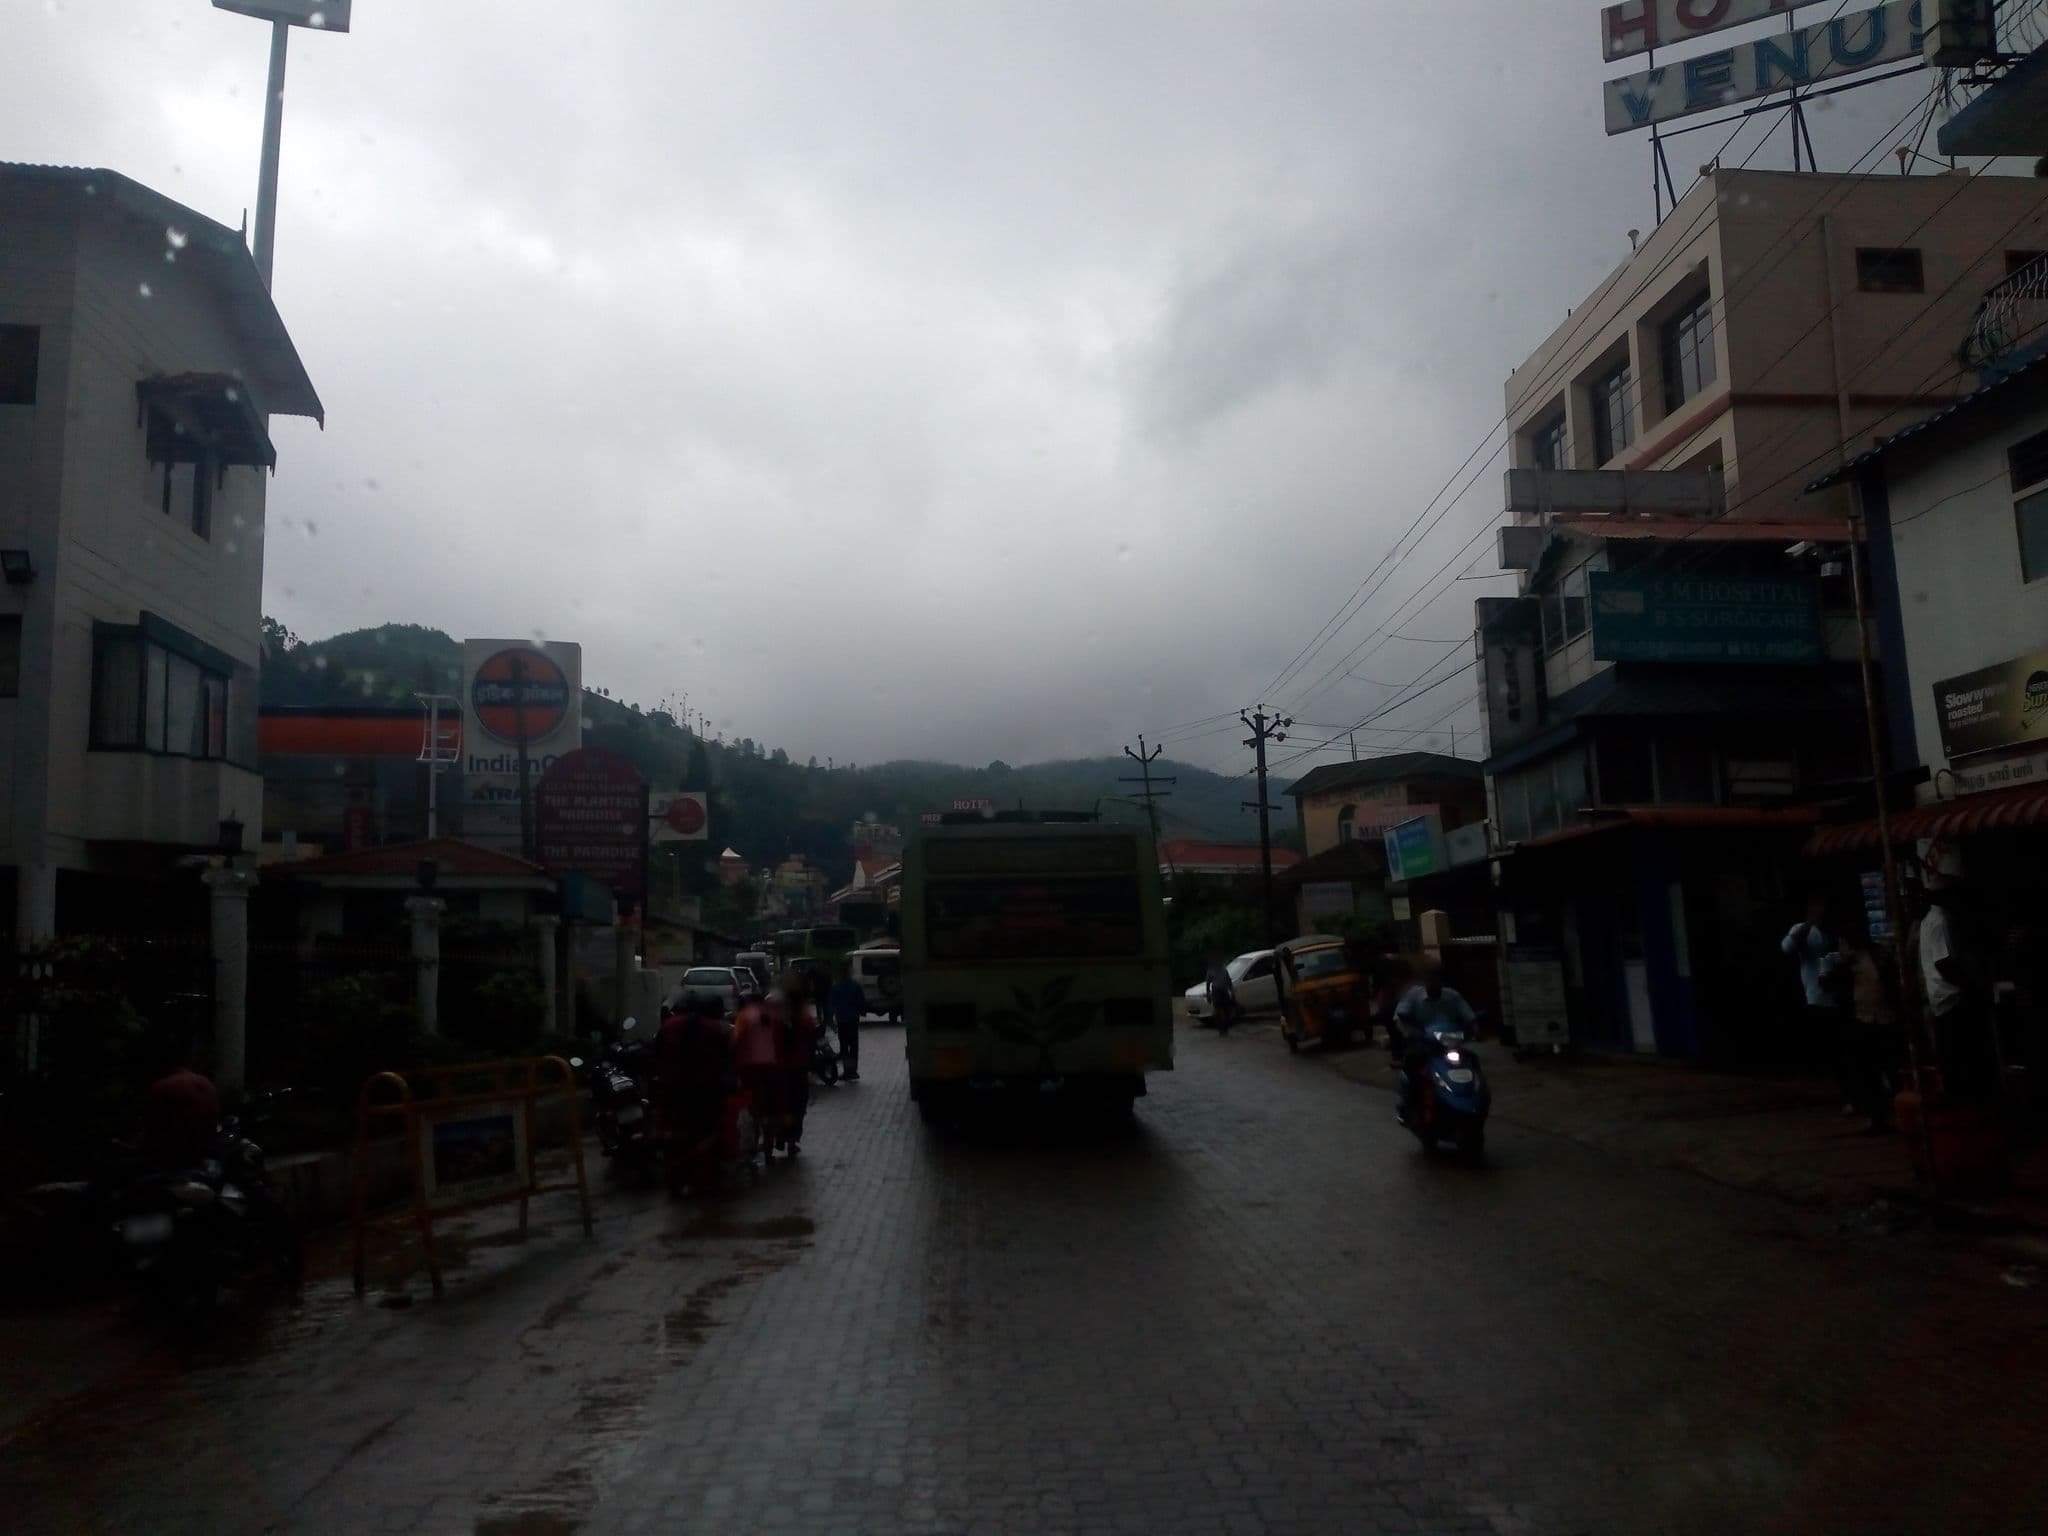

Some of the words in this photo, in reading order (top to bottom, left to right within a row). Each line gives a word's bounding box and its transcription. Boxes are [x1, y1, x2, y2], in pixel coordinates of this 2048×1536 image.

[1609, 0, 1788, 48] HO
[1699, 582, 1808, 602] HOSPITAL
[1948, 701, 1984, 721] roasted
[953, 799, 991, 810] HOTEL
[544, 846, 569, 857] THE
[573, 847, 640, 858] PARADISE
